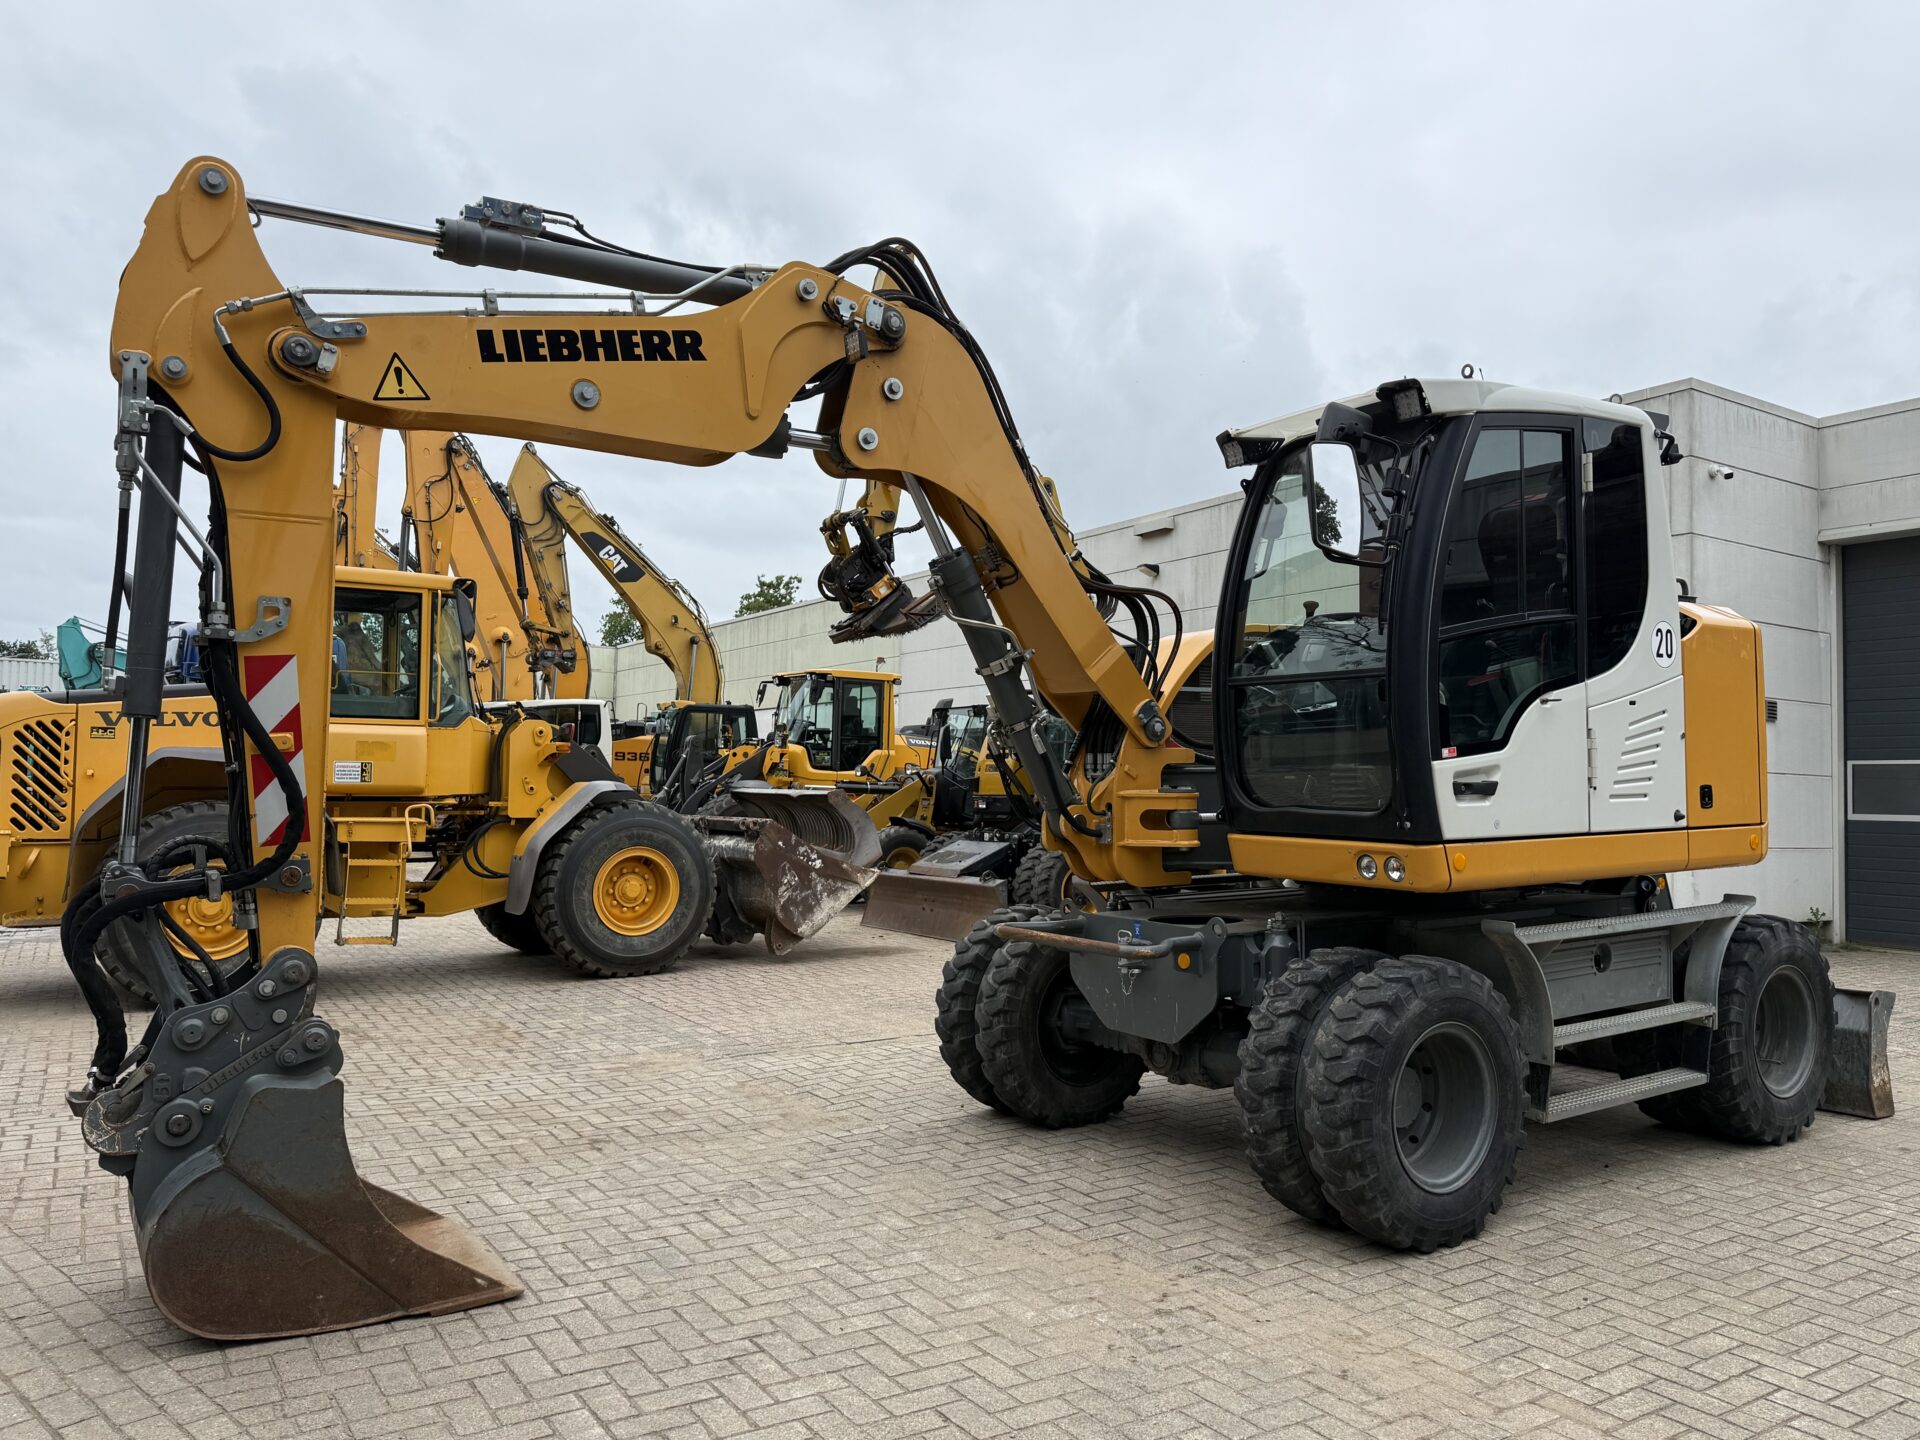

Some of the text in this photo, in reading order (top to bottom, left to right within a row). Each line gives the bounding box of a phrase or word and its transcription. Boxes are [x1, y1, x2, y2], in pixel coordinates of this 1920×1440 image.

[476, 329, 707, 362] LIEBHERR
[599, 545, 628, 574] CAT
[1656, 628, 1673, 659] 20
[95, 711, 220, 727] VLVO
[615, 752, 649, 761] 936
